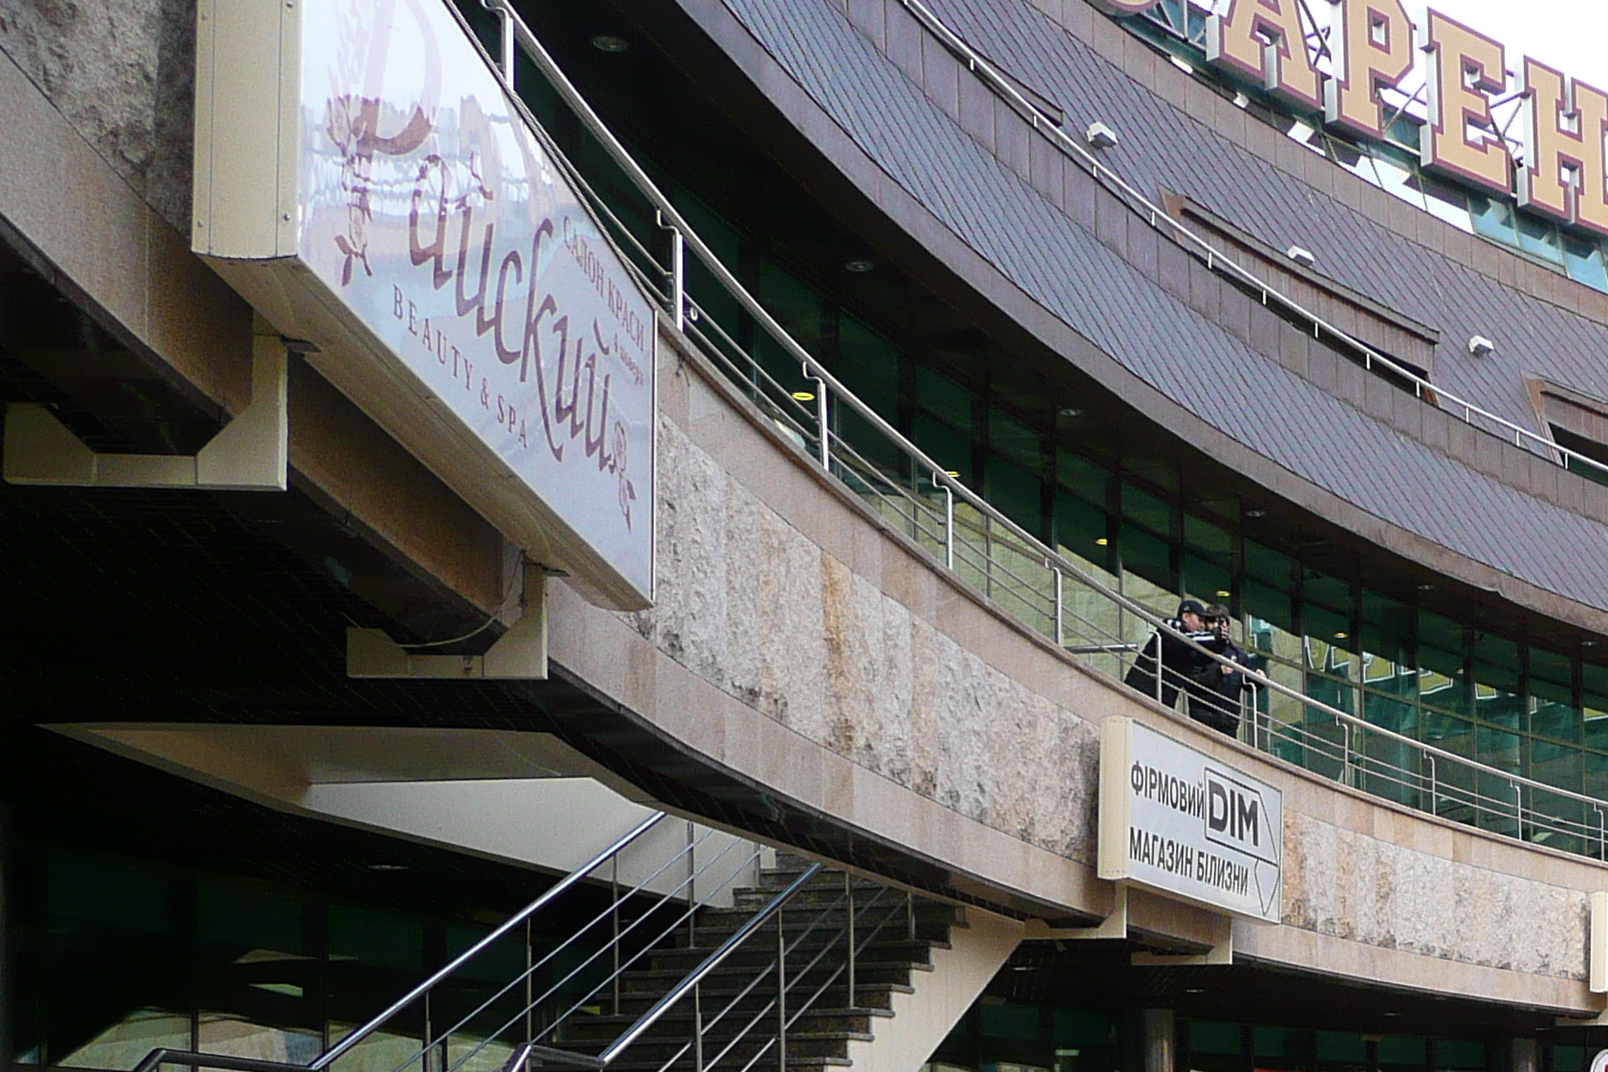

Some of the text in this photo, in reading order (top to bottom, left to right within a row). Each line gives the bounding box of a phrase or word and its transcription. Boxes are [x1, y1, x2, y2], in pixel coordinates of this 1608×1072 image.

[563, 215, 604, 298] САЛОН
[392, 284, 528, 449] BEAUTY & SPA
[1130, 760, 1205, 820] ФІРМОВИЙ
[1208, 779, 1259, 848] DIM
[1129, 826, 1249, 897] МАГАЗИН БІЛИЗНИ
